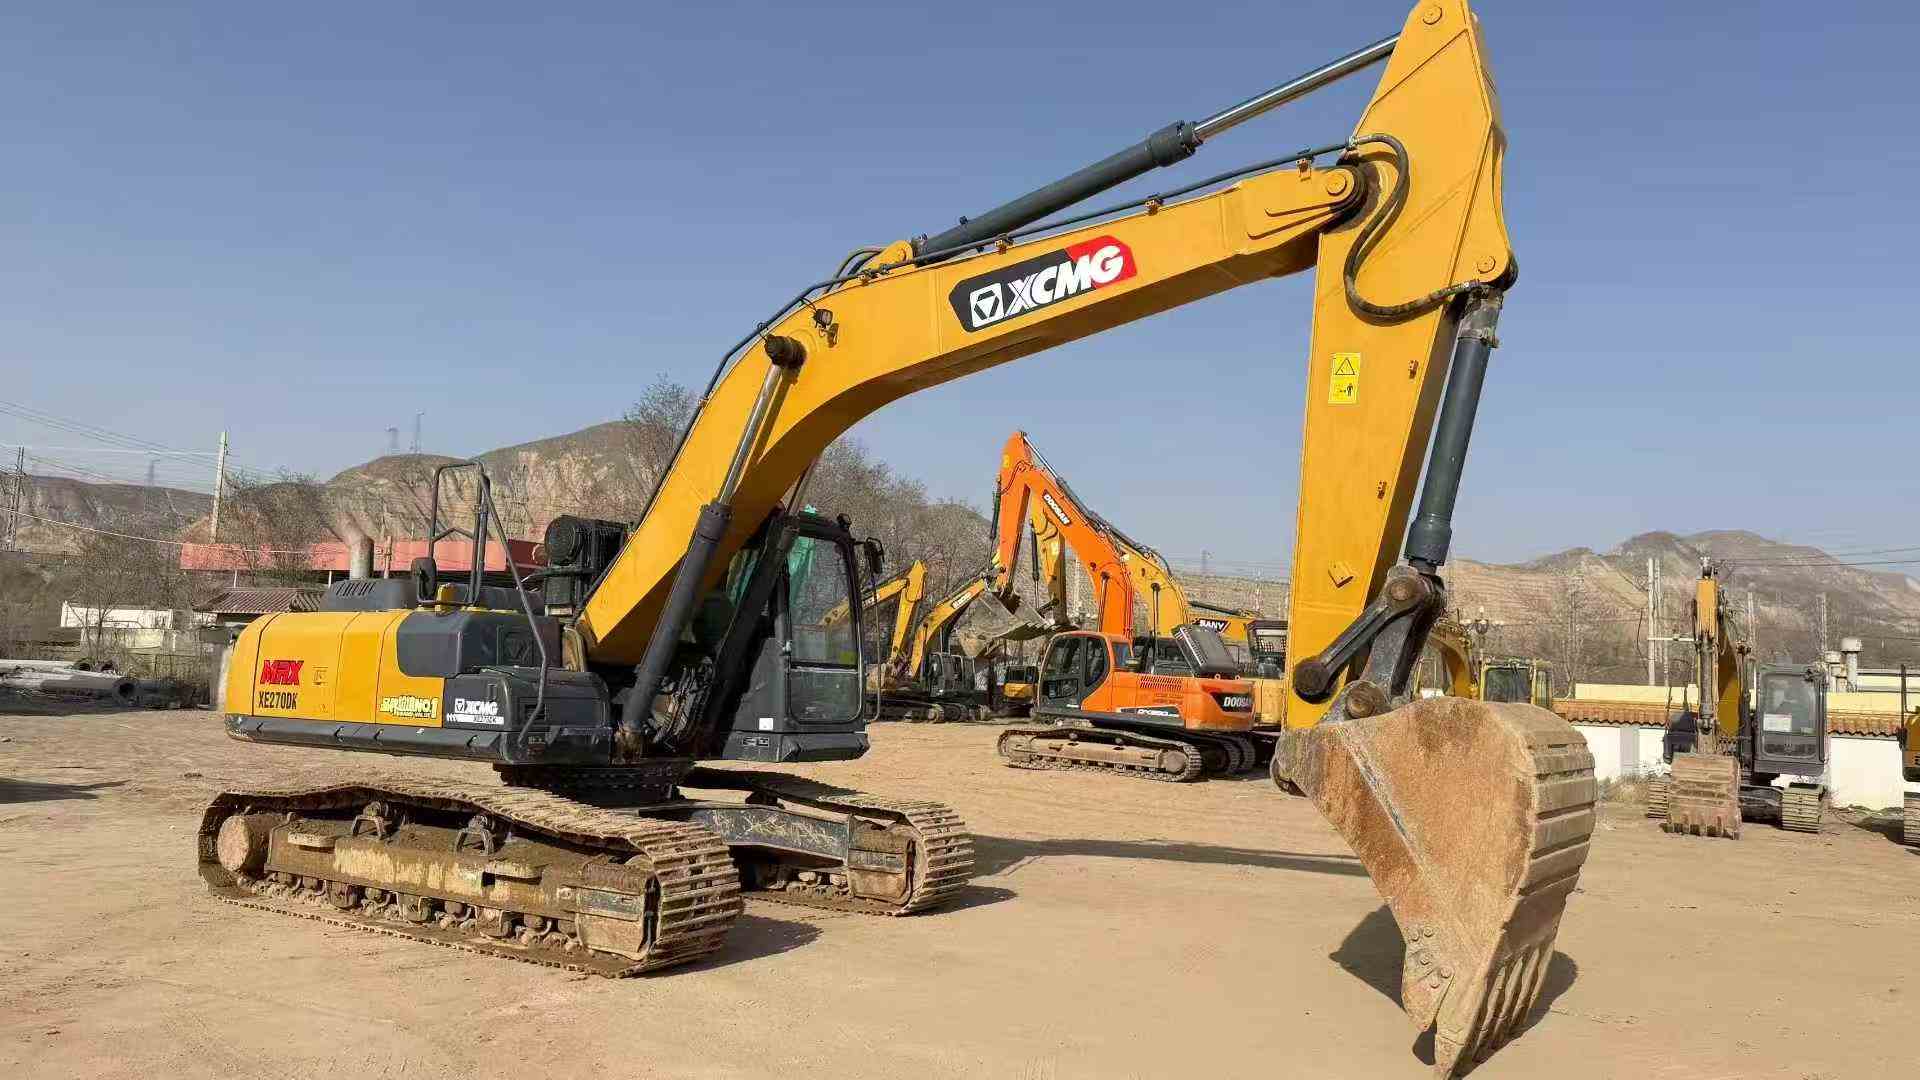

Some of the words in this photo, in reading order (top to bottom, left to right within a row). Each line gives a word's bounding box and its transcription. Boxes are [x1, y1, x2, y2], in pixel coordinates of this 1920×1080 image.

[1005, 245, 1124, 317] XCMG
[1043, 494, 1070, 525] DOOSAN
[1200, 619, 1225, 630] SANY
[259, 691, 298, 710] XE270DK
[464, 700, 498, 716] XCMG
